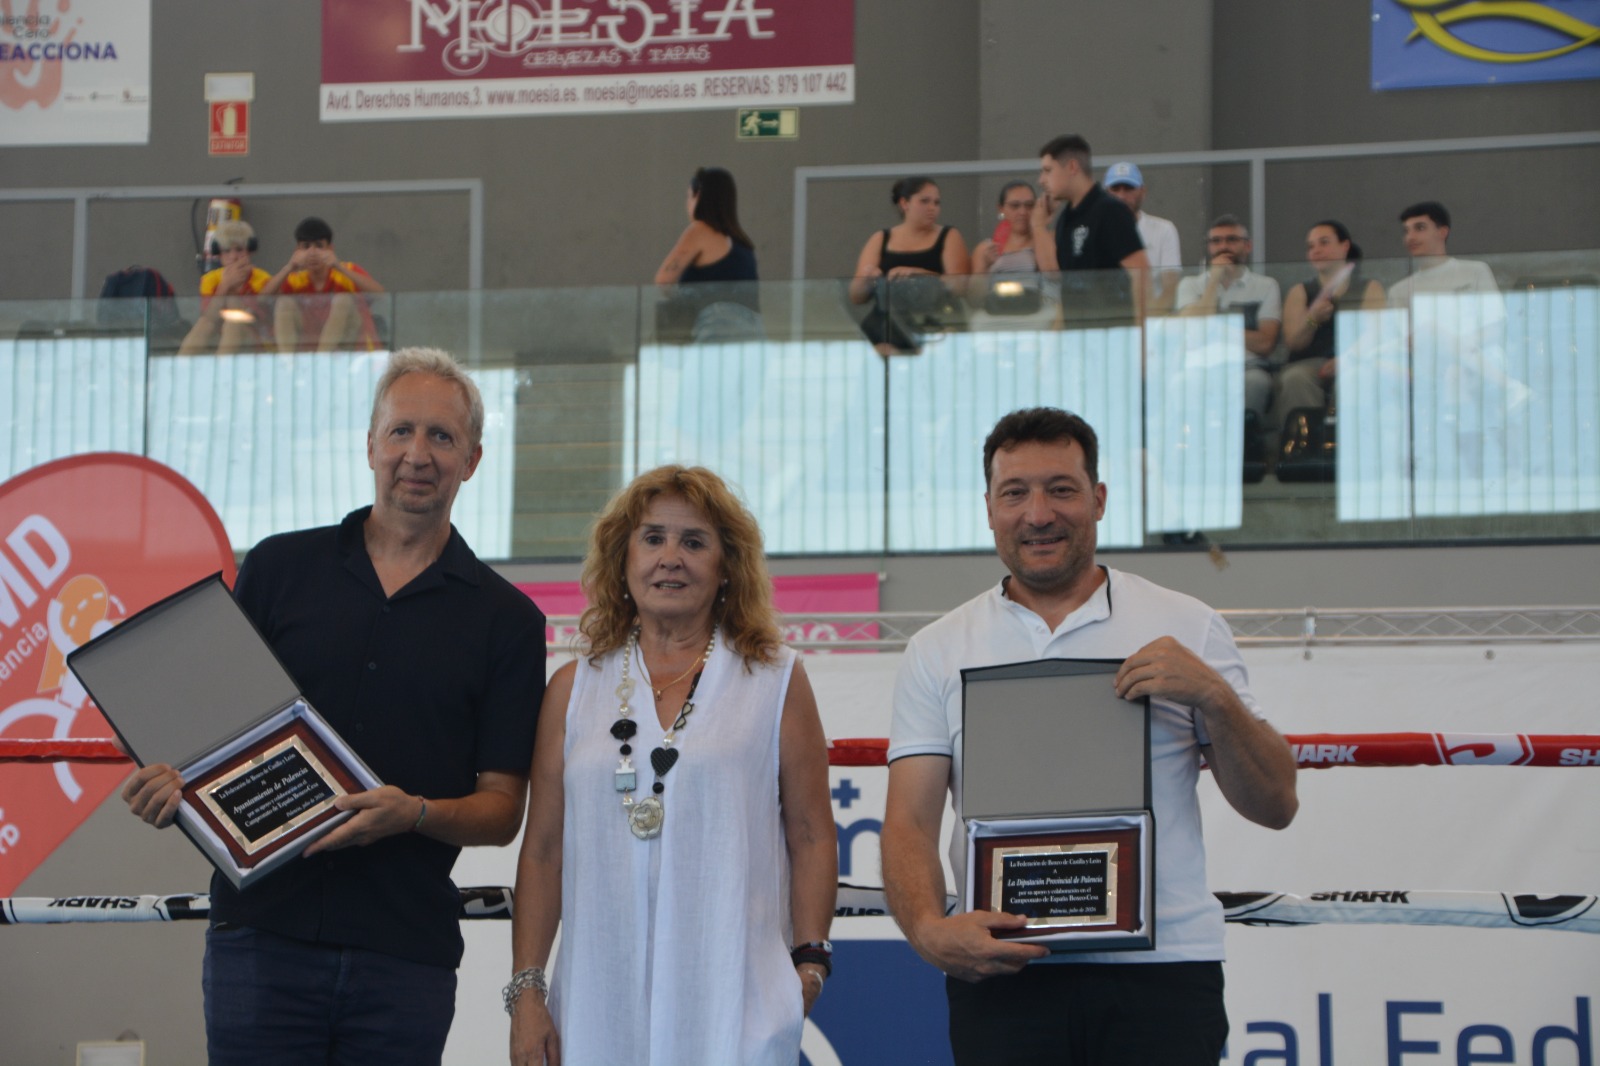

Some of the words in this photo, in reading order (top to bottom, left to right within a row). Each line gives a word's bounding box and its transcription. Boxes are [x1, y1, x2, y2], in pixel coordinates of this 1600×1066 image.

[0, 42, 118, 62] EACCIONA
[649, 44, 712, 63] TAPAS
[355, 89, 411, 110] Derechos
[777, 74, 799, 94] 979
[802, 73, 823, 93] 107
[826, 72, 847, 92] 442
[231, 785, 275, 817] Ayuntamiento
[272, 781, 283, 791] de
[281, 765, 309, 786] Palencia
[244, 807, 274, 830] Campeonato
[277, 795, 295, 810] España
[1007, 878, 1016, 887] La
[1016, 877, 1045, 888] Diputación
[1045, 876, 1073, 885] Provincial
[1073, 875, 1080, 884] de
[1080, 875, 1103, 884] Palencia
[46, 896, 140, 909] SHARK
[1010, 896, 1043, 905] Campeonato
[1050, 895, 1069, 904] España
[1311, 891, 1410, 904] SHARK
[1385, 996, 1593, 1066] Fed
